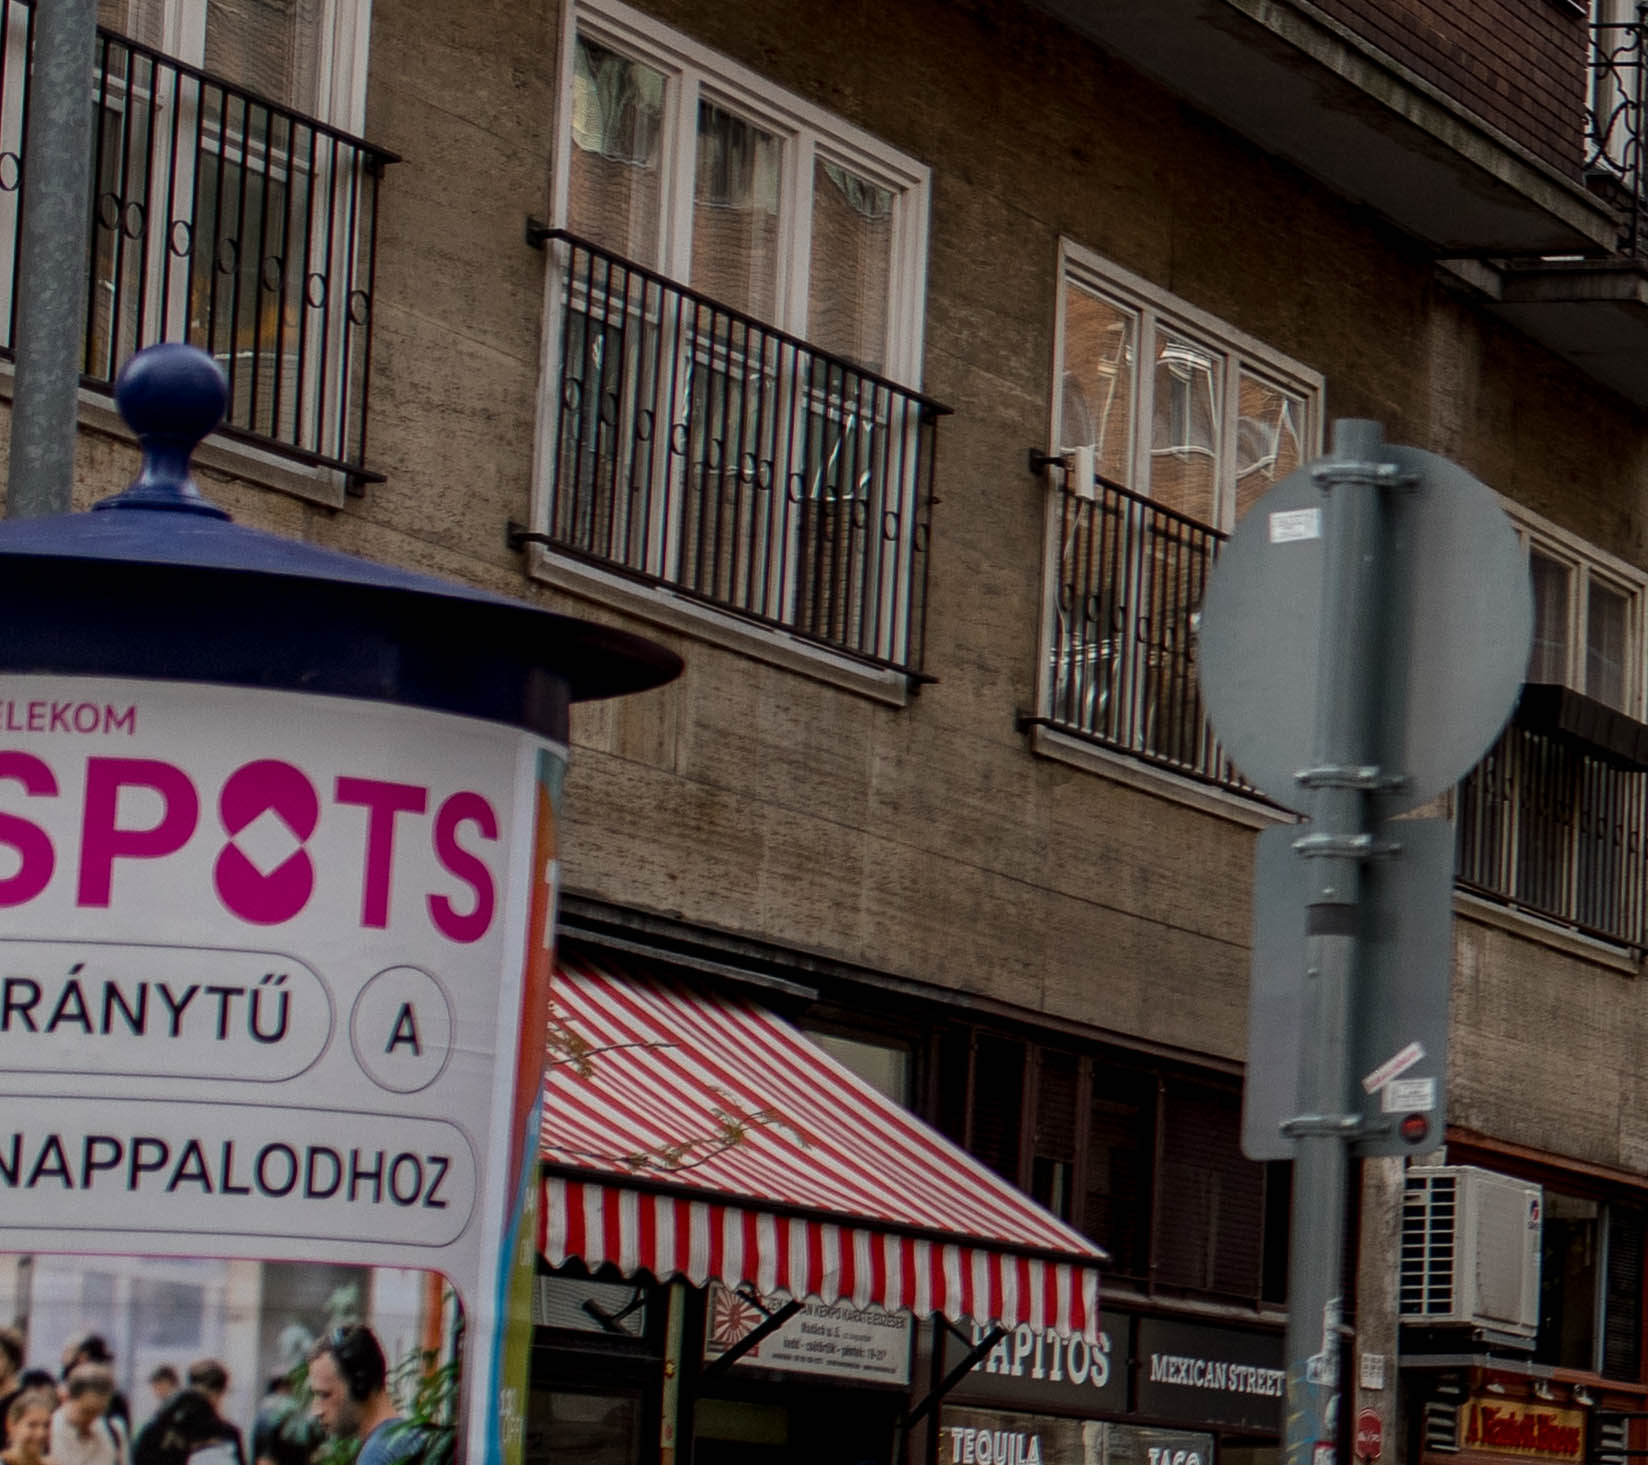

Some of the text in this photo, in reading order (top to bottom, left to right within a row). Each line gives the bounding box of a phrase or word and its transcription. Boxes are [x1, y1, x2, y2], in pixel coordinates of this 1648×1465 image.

[0, 700, 138, 736] LEKOM
[0, 963, 293, 1044] RÁNYTŰ
[384, 1002, 423, 1058] A
[1150, 1353, 1285, 1396] MEXICAN STREET
